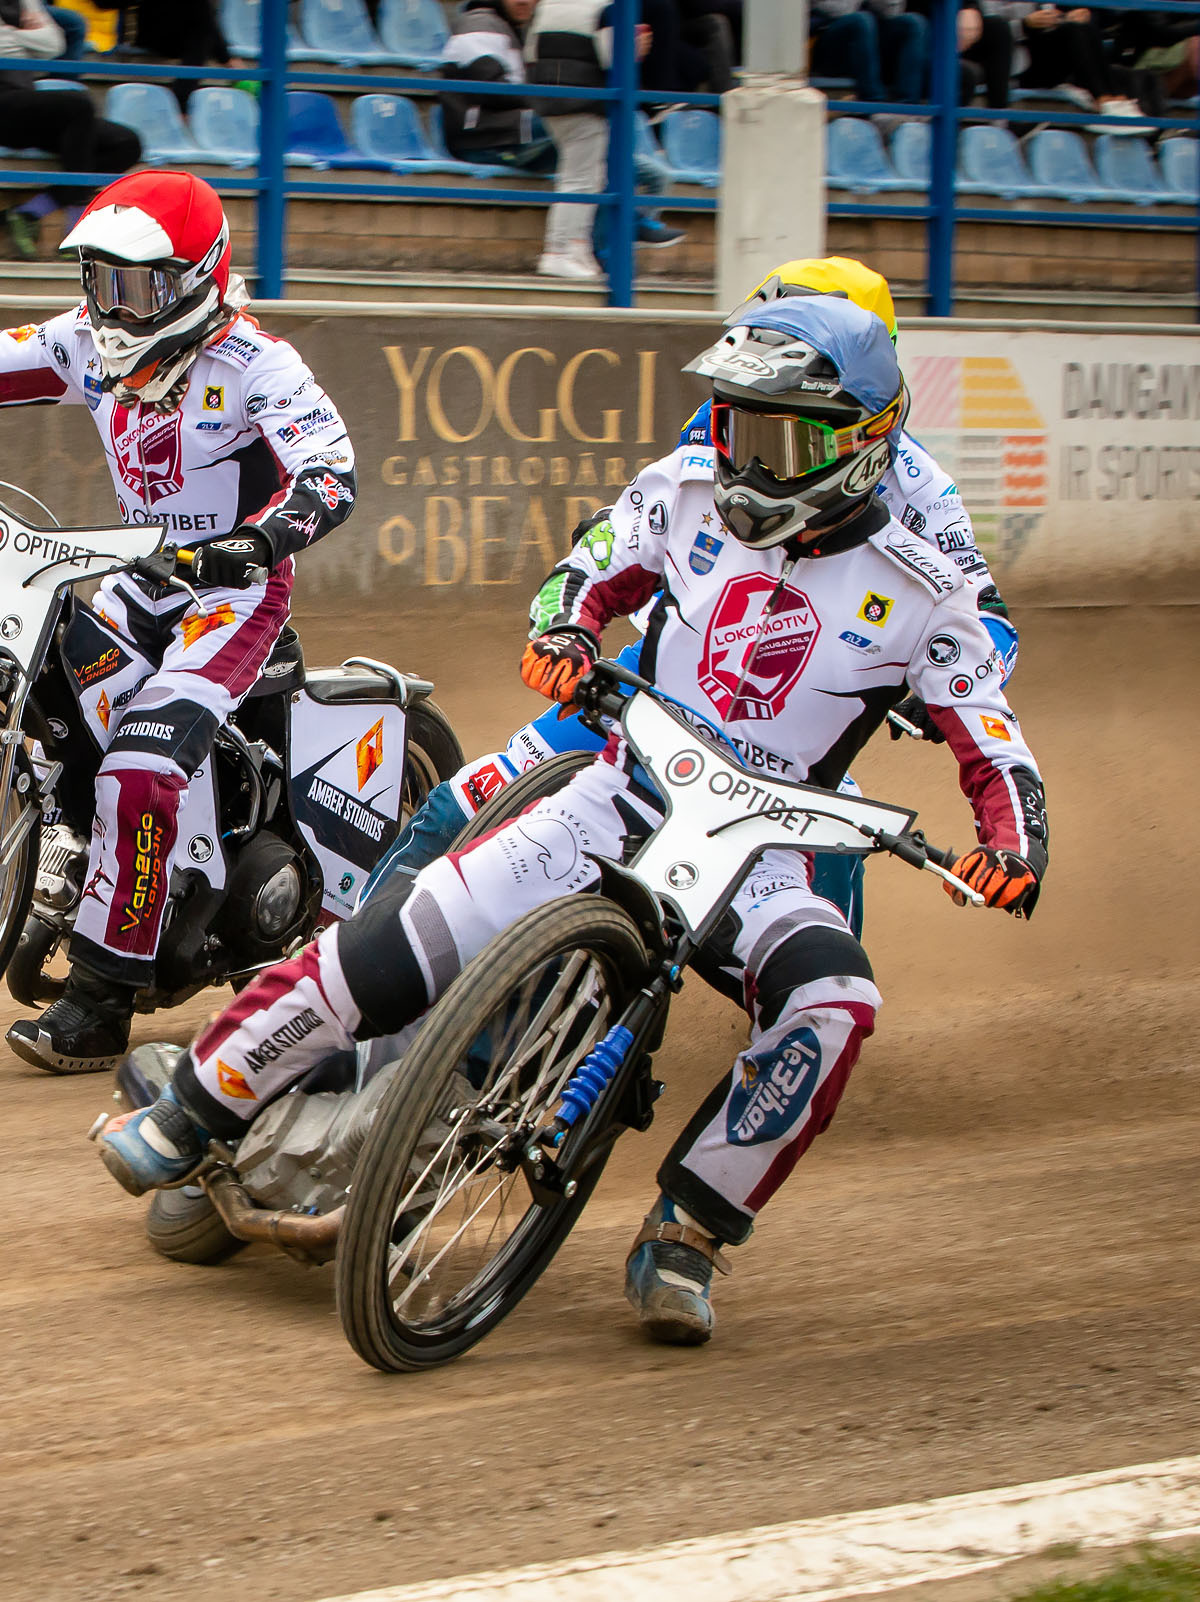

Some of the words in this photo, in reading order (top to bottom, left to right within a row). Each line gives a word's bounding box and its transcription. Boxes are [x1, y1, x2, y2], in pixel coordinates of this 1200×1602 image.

[725, 355, 767, 372] Arai
[381, 345, 659, 443] YOGGI
[13, 531, 97, 570] OPTIBET
[886, 530, 955, 591] Interio
[714, 612, 810, 646] LOKOMOTIV
[73, 648, 120, 678] Van2Go
[80, 660, 118, 685] LONDON
[117, 721, 175, 741] STUDIOS
[307, 777, 346, 816] AMBER
[343, 798, 386, 843] STUDIOS
[708, 770, 819, 837] OPTIBET
[559, 809, 591, 847] BEACH
[120, 812, 153, 932] Van2Go
[144, 826, 164, 919] LONDON
